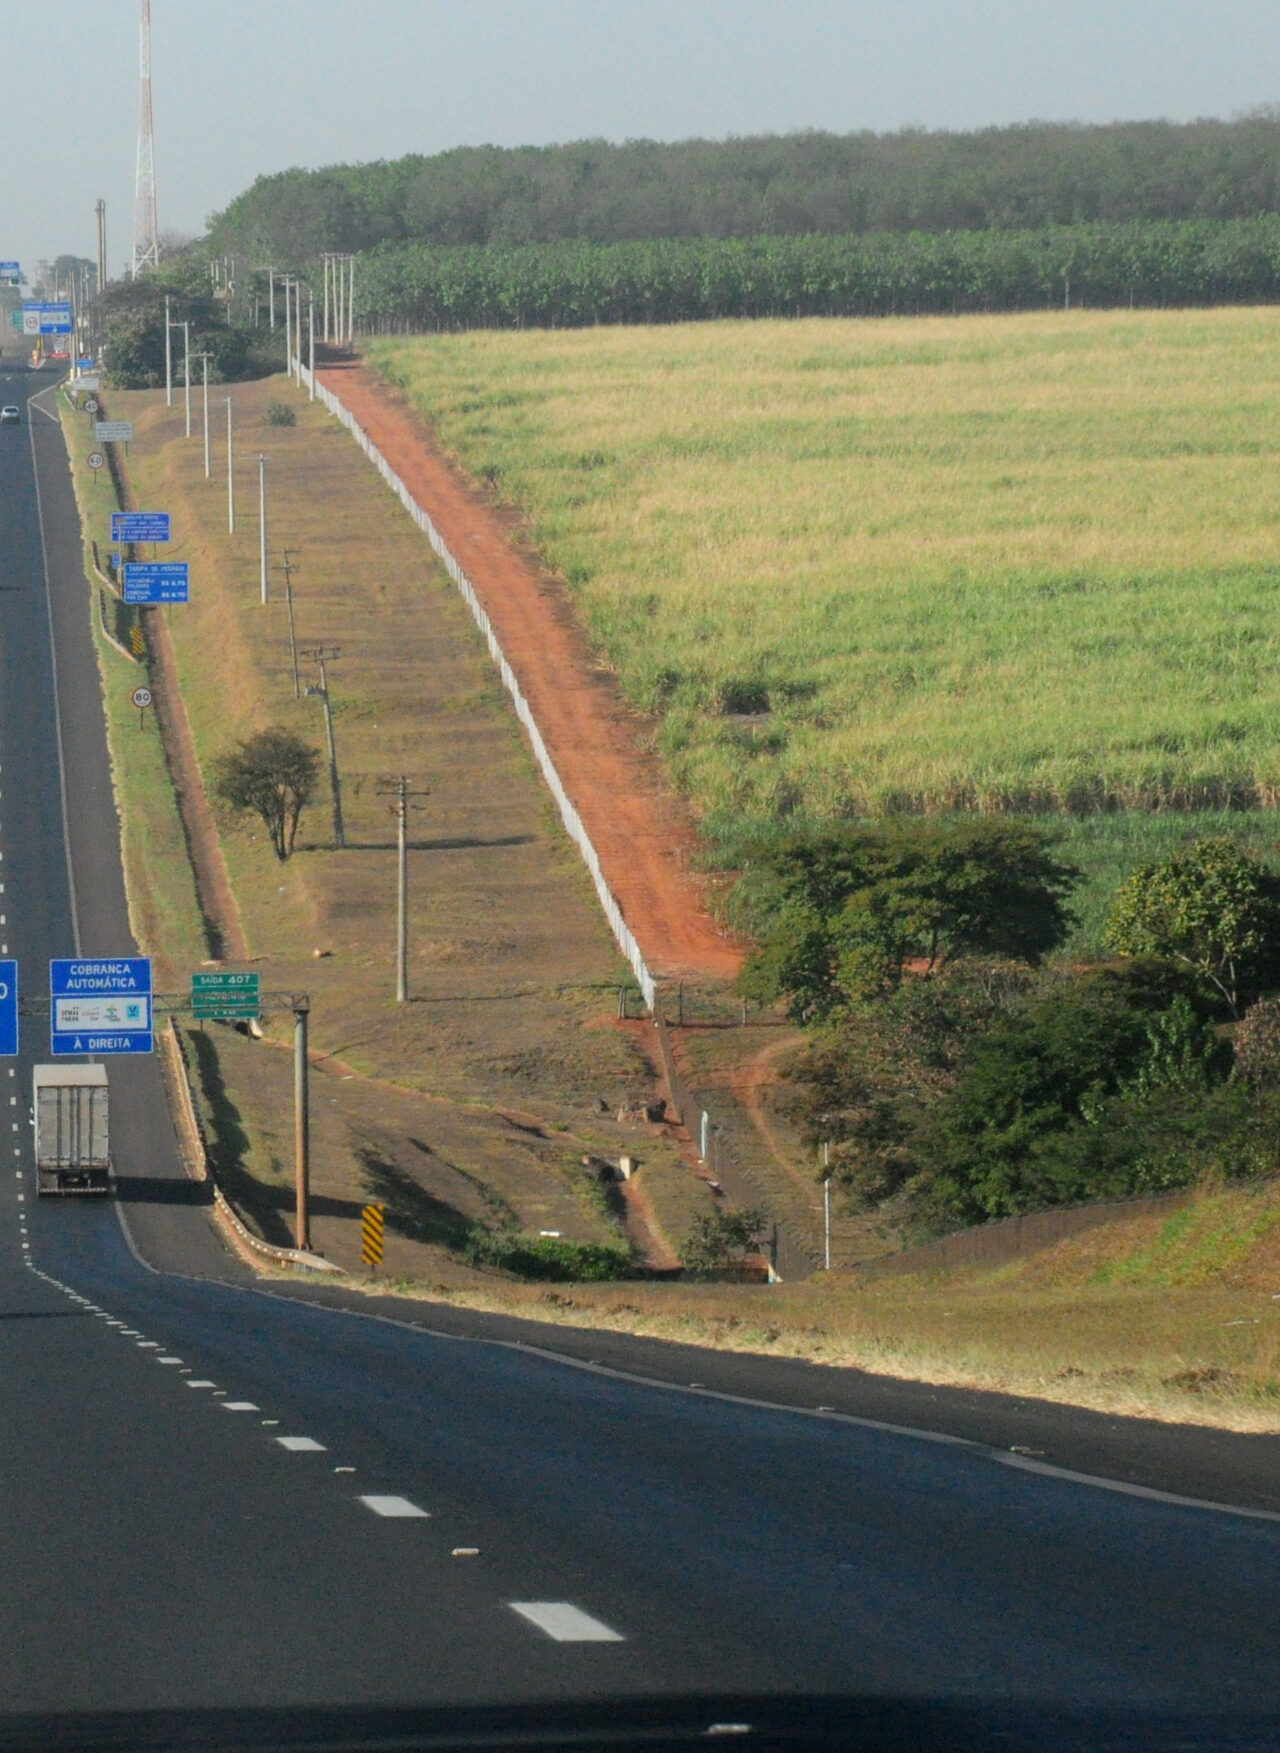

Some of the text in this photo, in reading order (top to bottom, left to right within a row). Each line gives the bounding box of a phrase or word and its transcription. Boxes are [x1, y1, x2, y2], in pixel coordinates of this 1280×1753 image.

[135, 693, 149, 701] 80
[66, 975, 136, 989] AUTOMÁTICA
[228, 975, 251, 984] 407
[73, 1035, 131, 1050] À DIREITA
